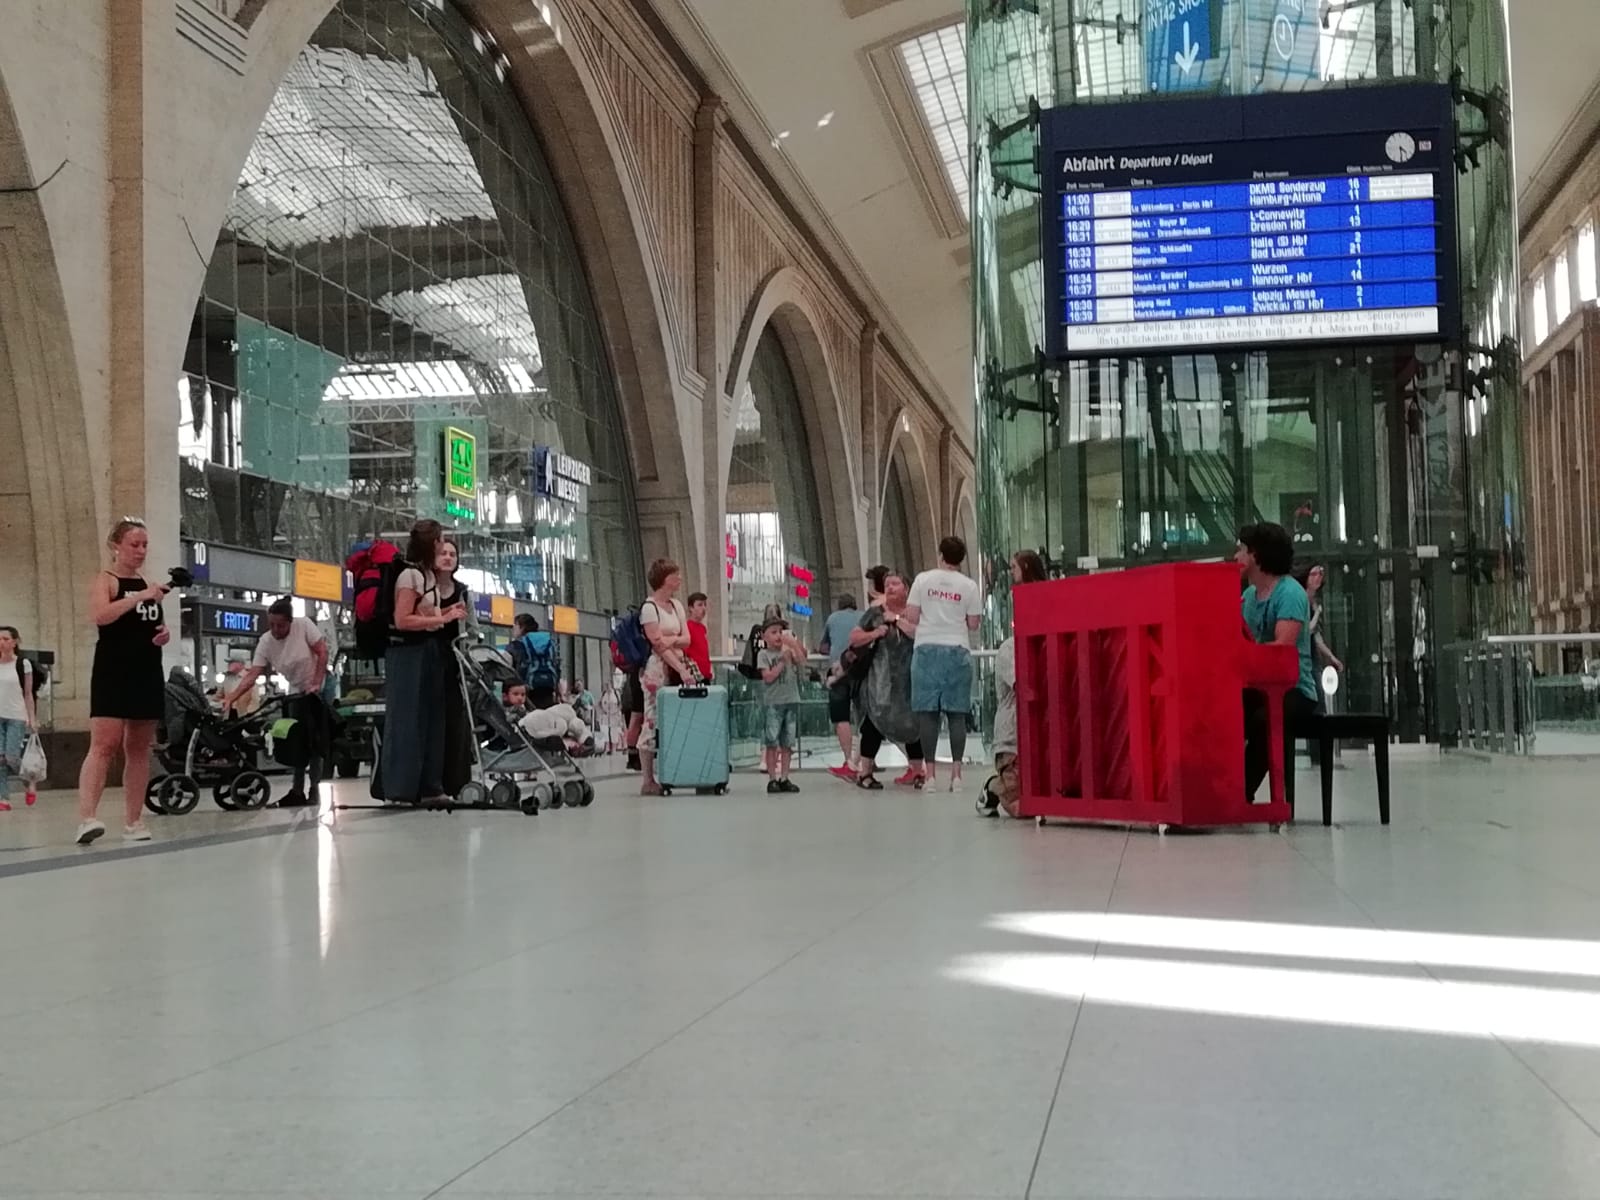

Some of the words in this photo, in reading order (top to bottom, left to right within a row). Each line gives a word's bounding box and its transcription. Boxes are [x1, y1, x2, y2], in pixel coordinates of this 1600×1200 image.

[1063, 155, 1115, 173] Abfahrt
[1120, 155, 1171, 171] Departure
[1181, 152, 1213, 167] Départ
[1250, 182, 1276, 195] DKMS
[1279, 180, 1326, 194] Sonderzug
[1348, 189, 1360, 200] 11
[1066, 194, 1090, 206] 11:00
[1250, 192, 1322, 206] Hamburg-Altona
[1250, 208, 1305, 222] L-Connewitz
[1251, 220, 1287, 233] Dresden
[1290, 218, 1306, 230] Hbf
[1251, 236, 1274, 248] Halle
[1292, 234, 1307, 246] Hbf
[1251, 247, 1268, 260] Bad
[1252, 263, 1288, 275] Wurzen
[1252, 274, 1294, 287] Hannover
[1297, 272, 1313, 284] Hbf
[1252, 289, 1283, 302] Leipzig
[1285, 287, 1316, 300] Messe
[1253, 300, 1290, 313] Zwickau
[1308, 297, 1324, 310] Hbf
[557, 452, 592, 486] LEIPZIGER
[557, 476, 581, 503] MESSE
[193, 542, 207, 566] 10
[224, 612, 251, 631] FRITTZ
